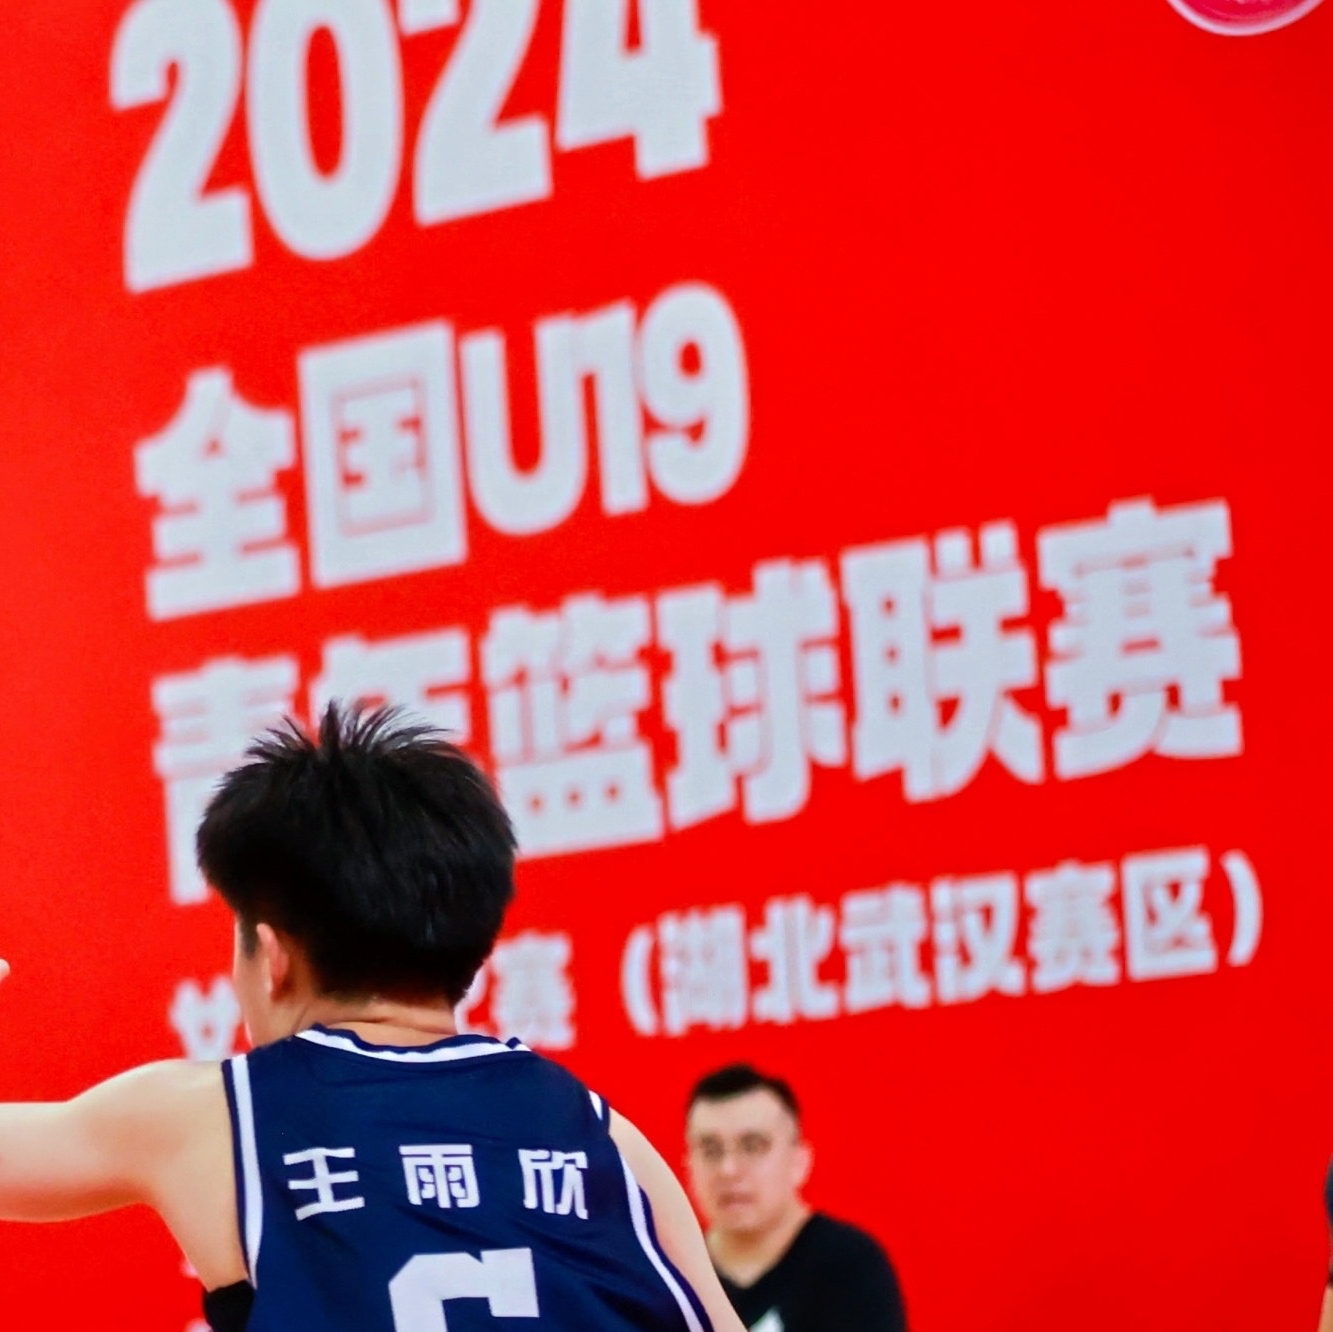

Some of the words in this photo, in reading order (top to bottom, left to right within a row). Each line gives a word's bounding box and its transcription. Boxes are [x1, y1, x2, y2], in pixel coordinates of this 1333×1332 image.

[109, 0, 724, 294] 2024
[135, 280, 751, 621] 全国U19
[283, 1143, 590, 1221] 王雨欣
